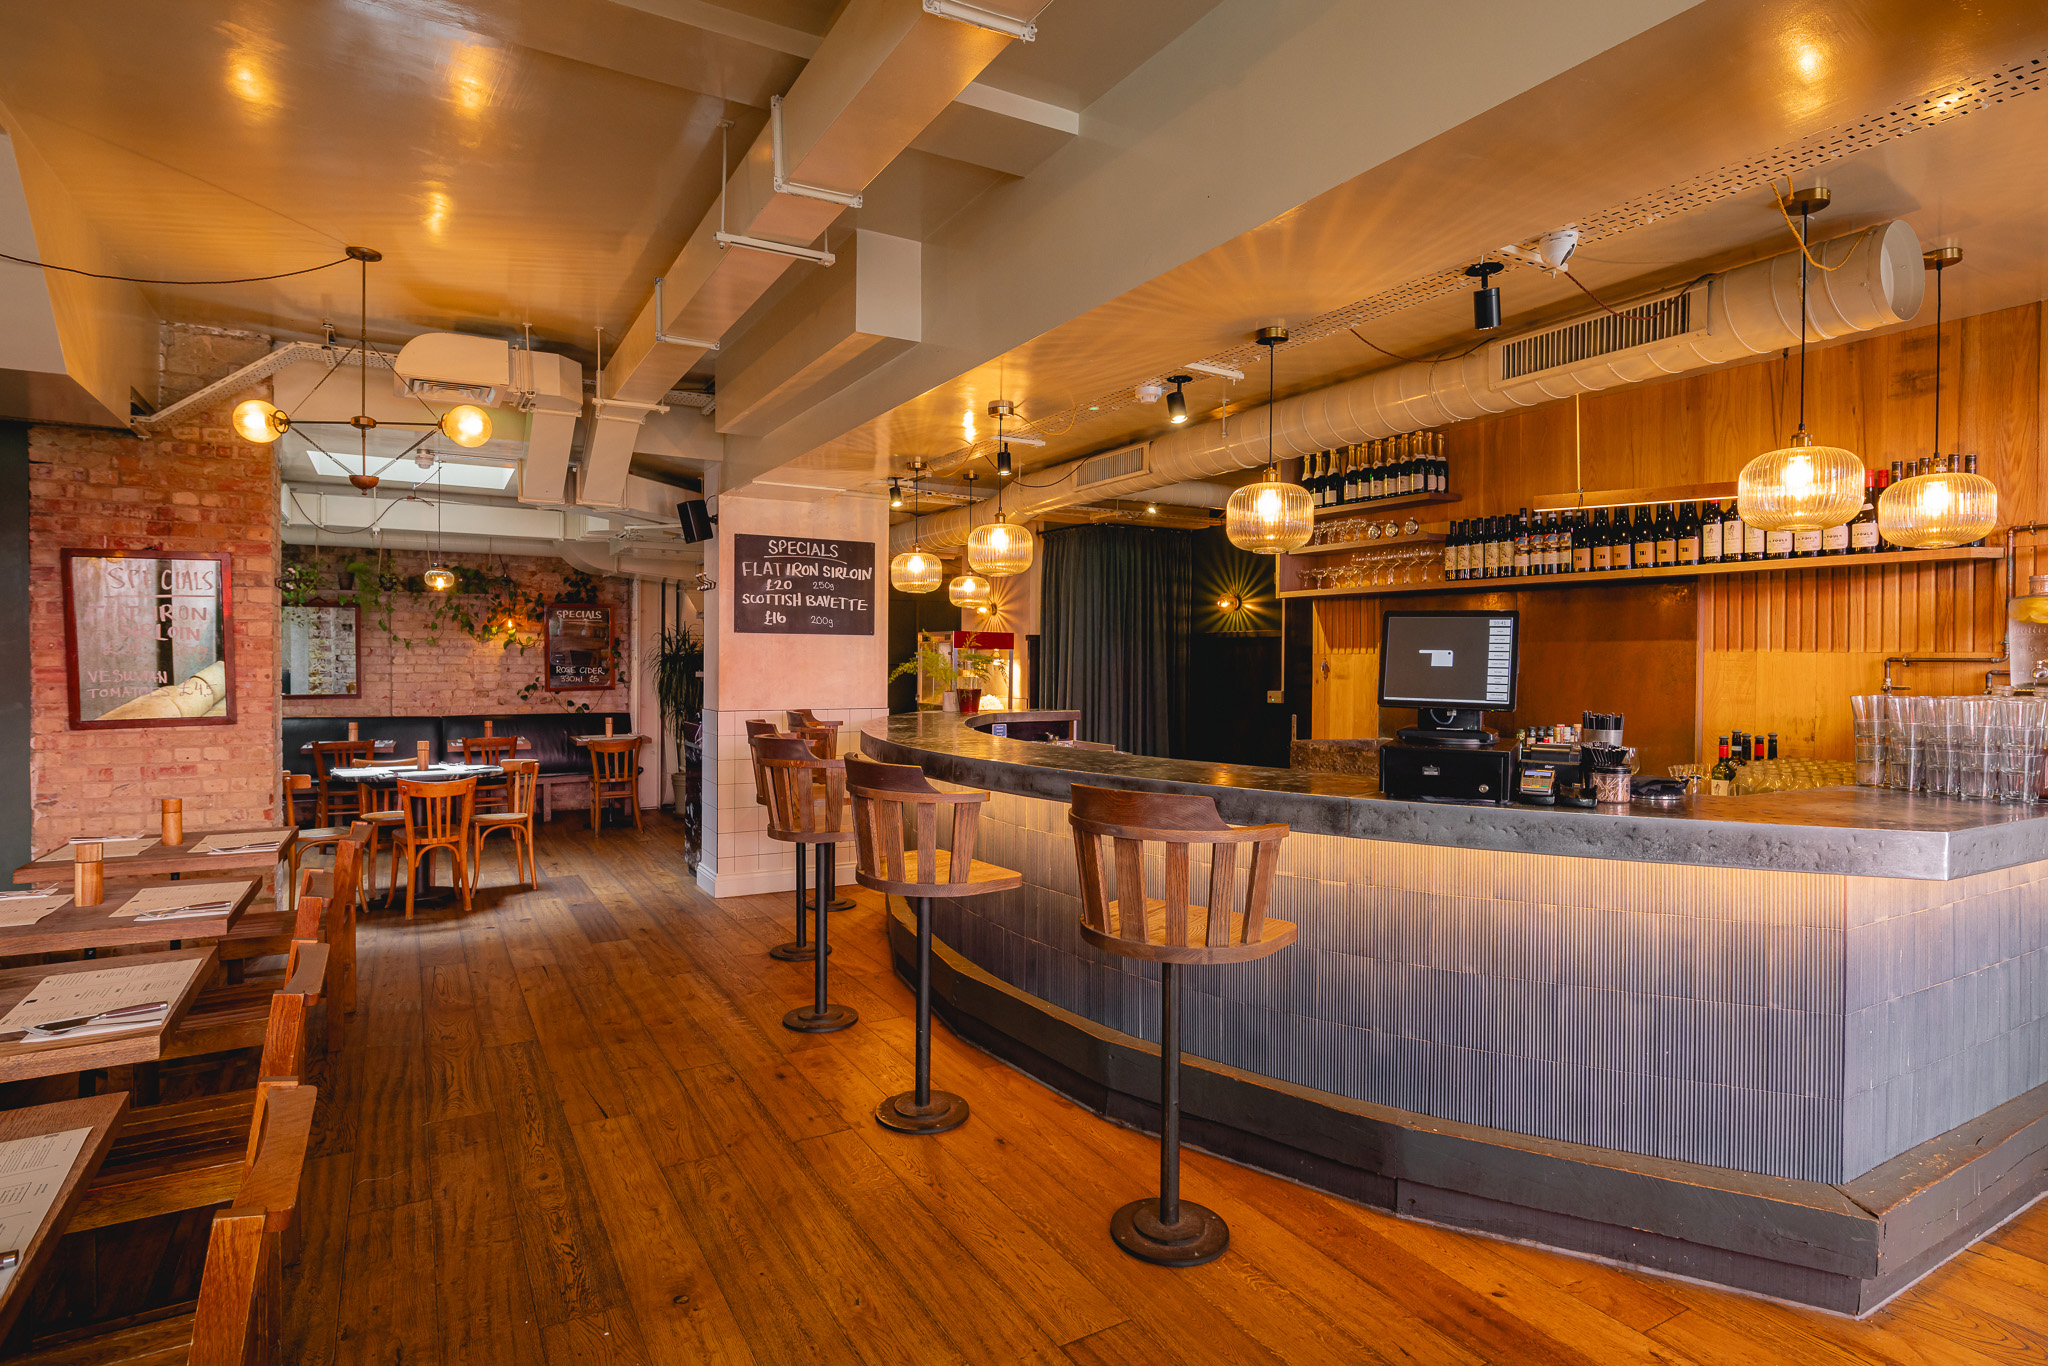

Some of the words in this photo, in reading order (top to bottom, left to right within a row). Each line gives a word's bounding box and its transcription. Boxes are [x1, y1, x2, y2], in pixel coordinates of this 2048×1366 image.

[768, 539, 839, 558] SPECIALS
[742, 561, 782, 577] FLAT
[786, 562, 819, 578] IRON
[823, 565, 873, 580] SIRLOIN
[107, 567, 214, 591] SPECIALS
[765, 579, 793, 591] £20
[812, 581, 835, 591] 250g
[742, 593, 802, 607] SCOTTISH
[806, 594, 869, 611] BAVETTE
[151, 603, 207, 622] IRON
[556, 610, 602, 619] SPECIALS
[764, 611, 787, 626] £16
[810, 616, 834, 628] 200g
[87, 670, 168, 684] VESUVIAN
[579, 666, 605, 675] CIDER
[589, 675, 599, 683] £5
[86, 686, 170, 699] TOMATOES
